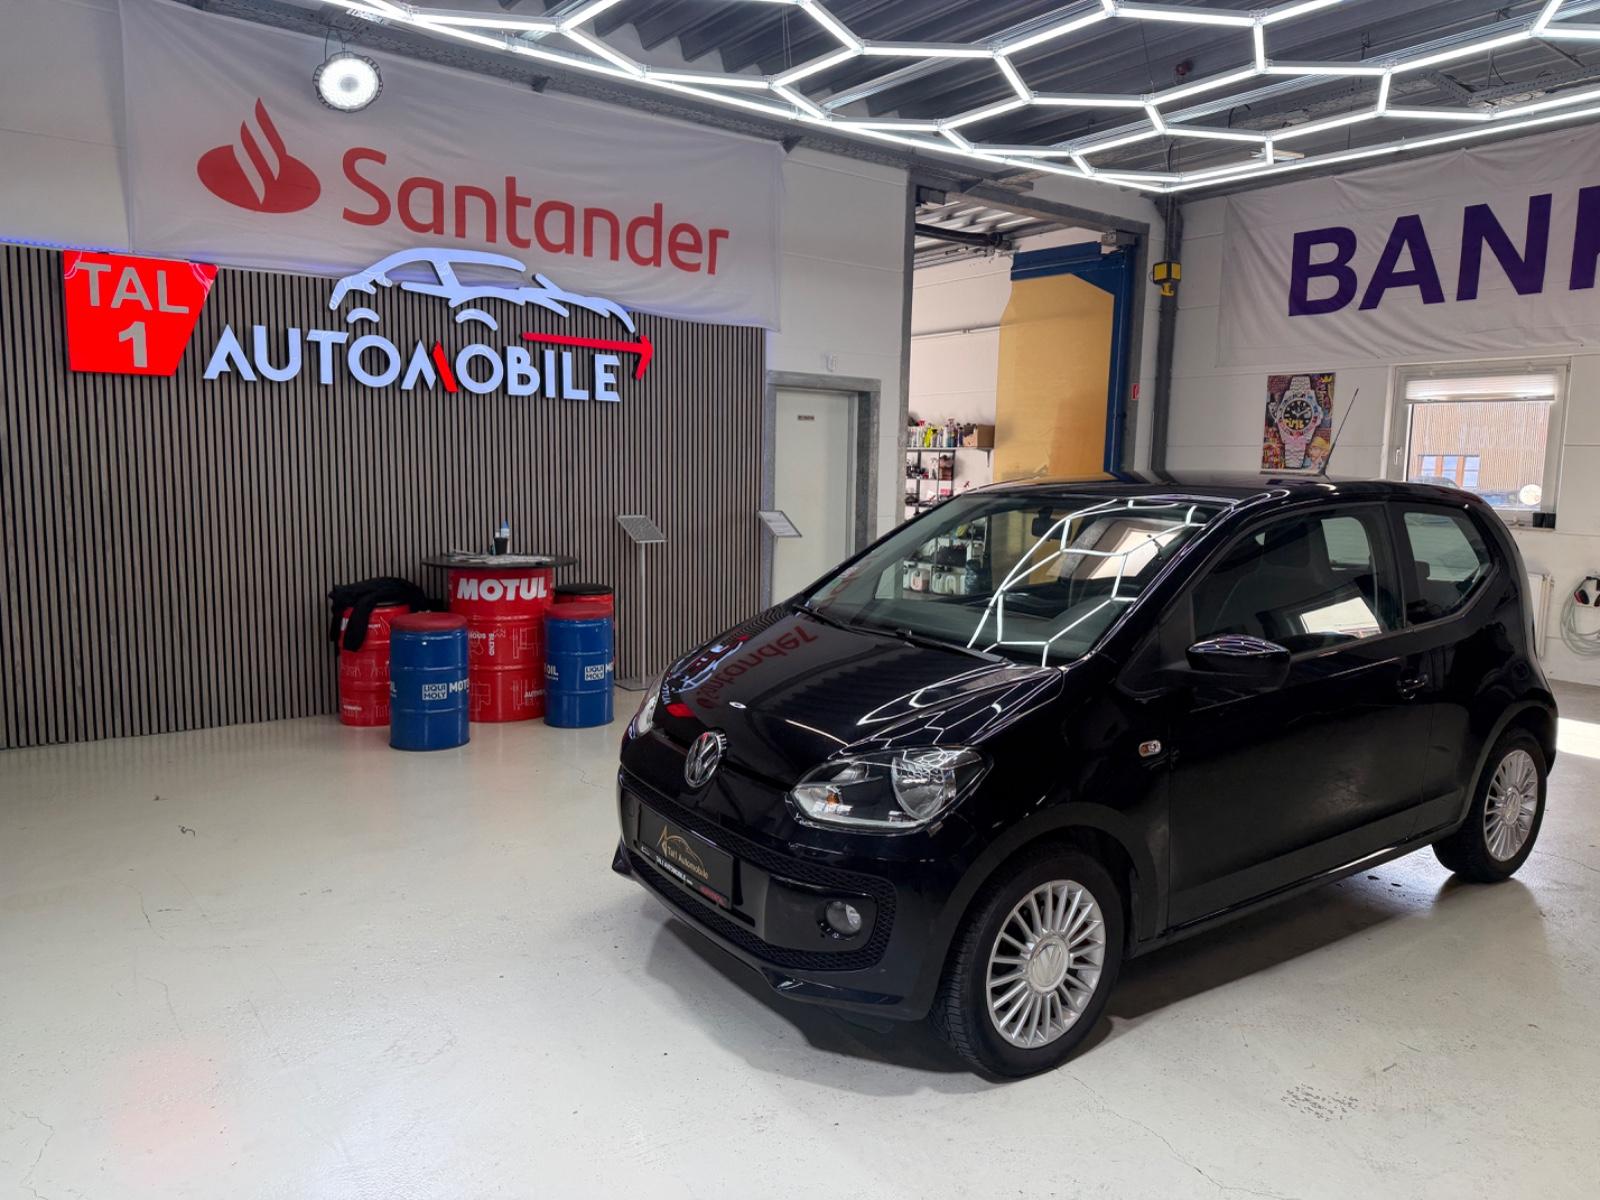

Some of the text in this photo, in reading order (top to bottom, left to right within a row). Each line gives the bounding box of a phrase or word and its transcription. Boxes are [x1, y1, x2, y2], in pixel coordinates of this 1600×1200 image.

[342, 147, 730, 276] Santander
[74, 261, 190, 315] TAL
[117, 321, 148, 369] 1
[203, 324, 621, 403] AUTOMOBILE
[456, 576, 548, 601] MOTUL
[423, 684, 446, 693] LIQUI
[424, 691, 446, 700] MOLY
